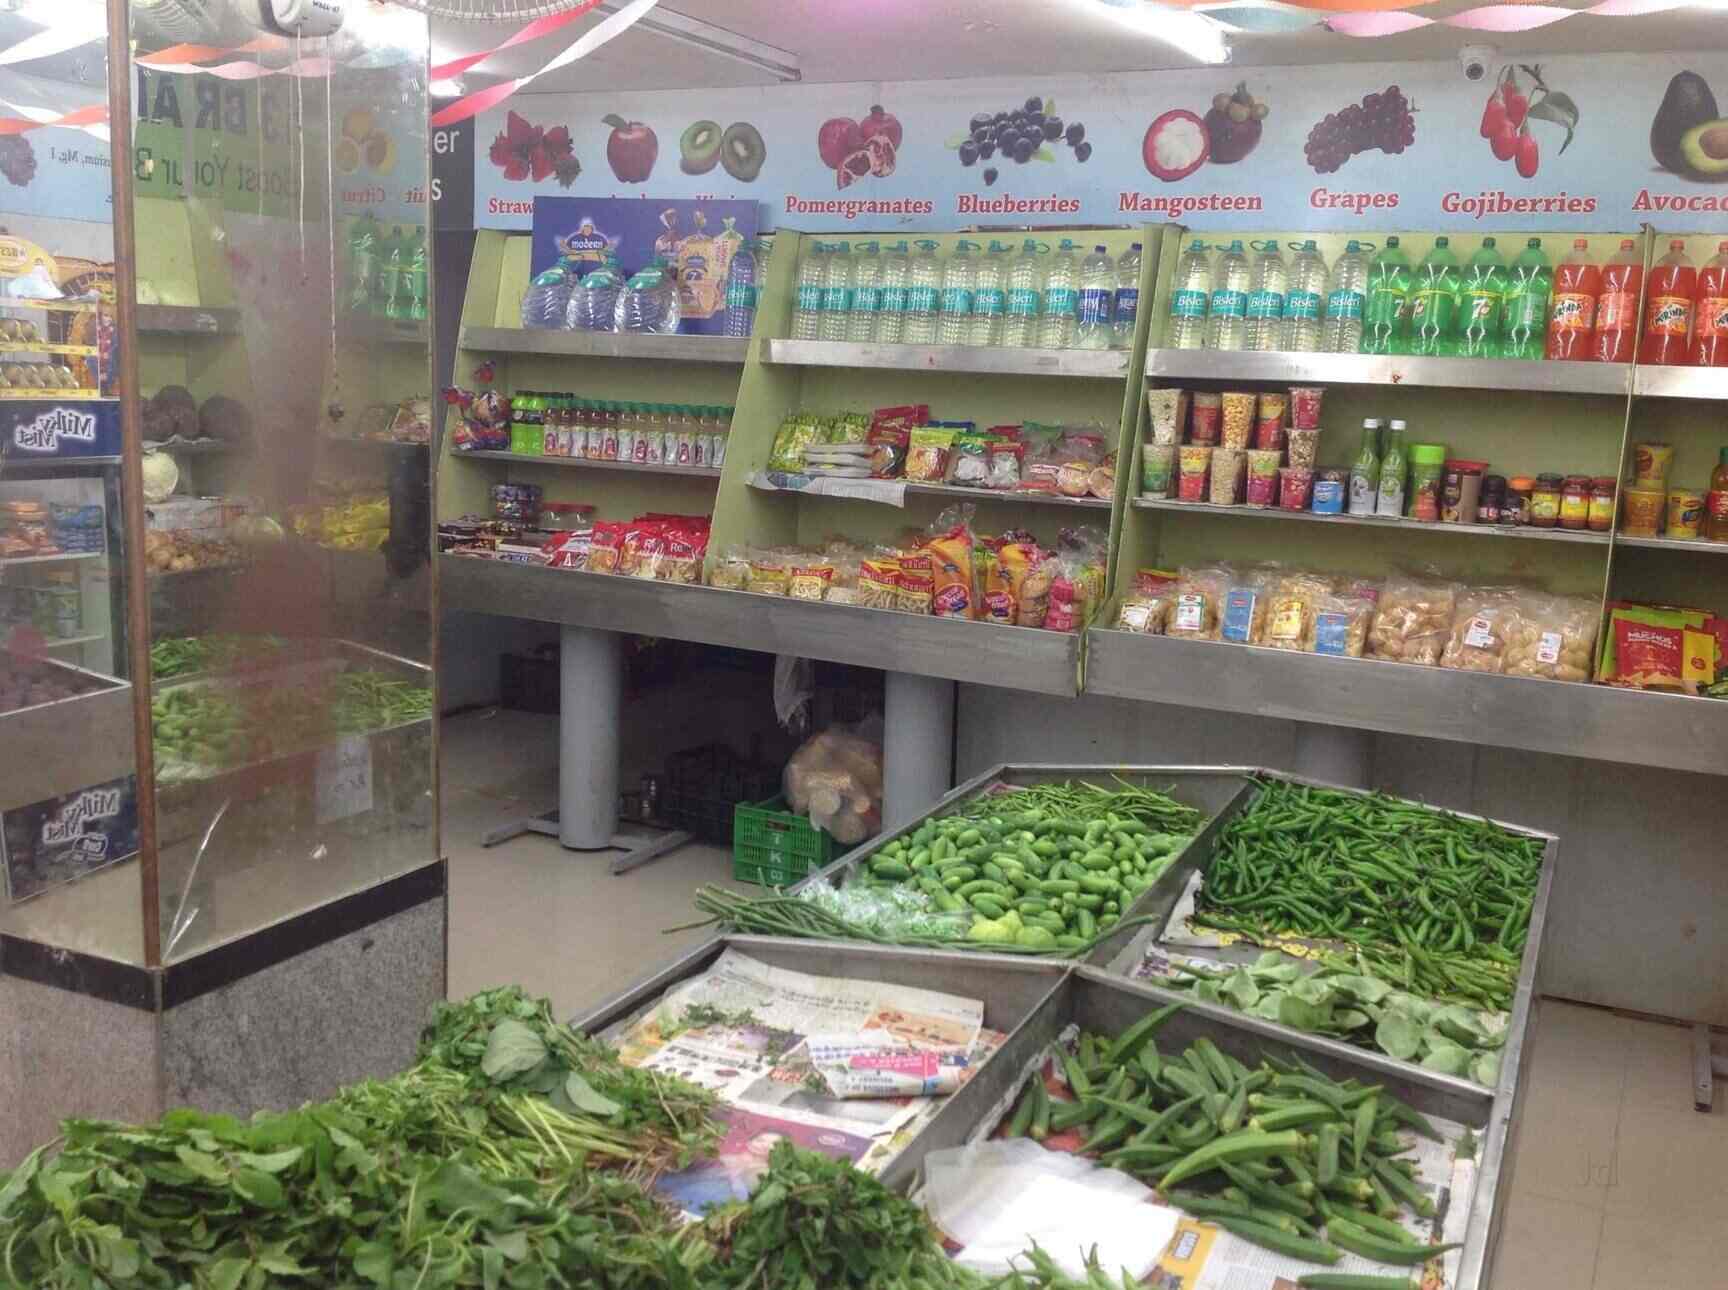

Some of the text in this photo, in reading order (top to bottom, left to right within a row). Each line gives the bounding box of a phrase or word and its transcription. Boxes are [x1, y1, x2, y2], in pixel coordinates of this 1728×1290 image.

[433, 130, 460, 153] er
[786, 195, 933, 219] Pomergranates
[958, 194, 1080, 214] Blueberries
[1119, 192, 1263, 217] Mangosteen
[1310, 188, 1400, 214] Grapes
[1441, 191, 1597, 219] Gojiberries
